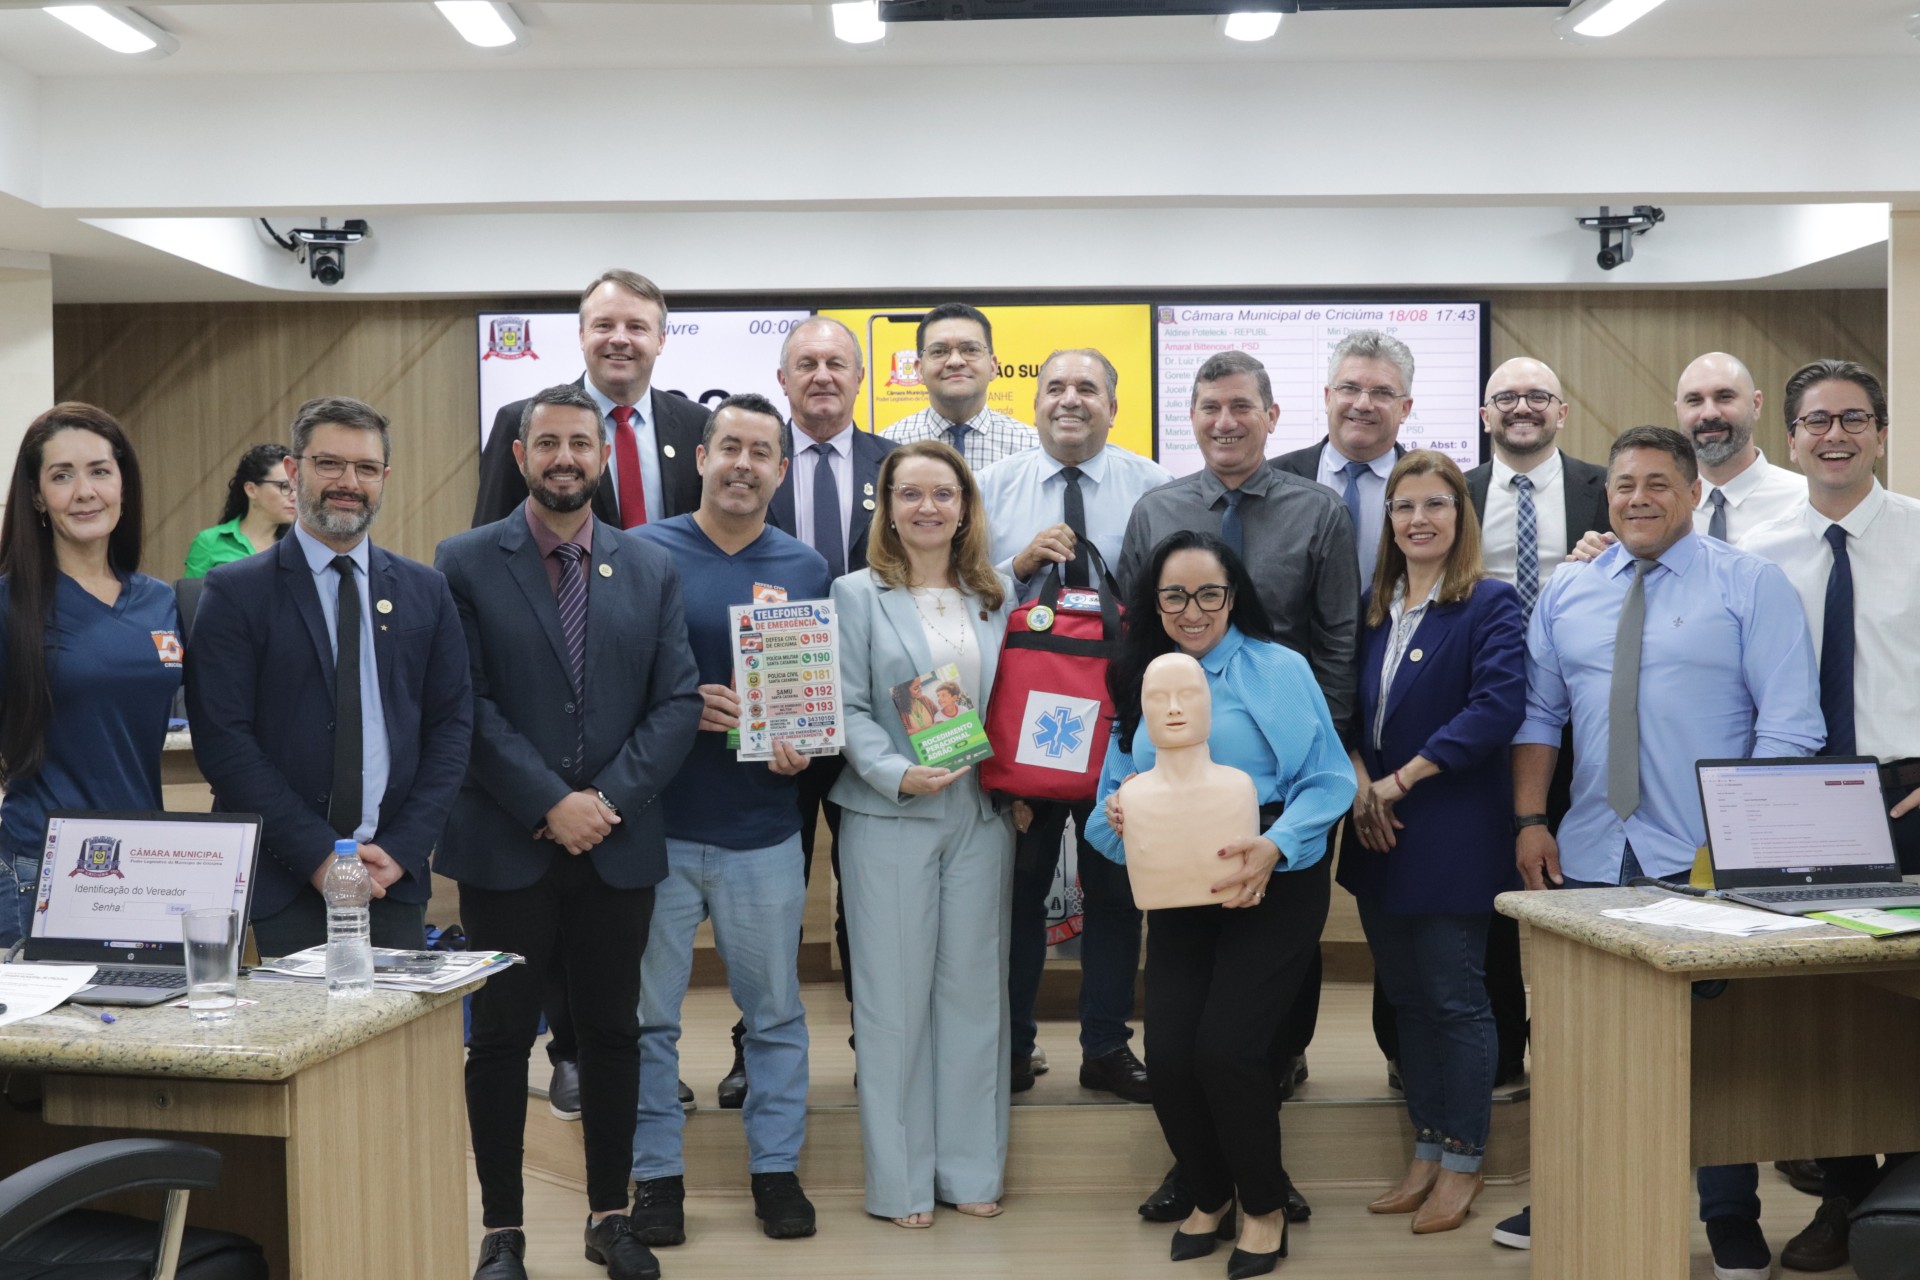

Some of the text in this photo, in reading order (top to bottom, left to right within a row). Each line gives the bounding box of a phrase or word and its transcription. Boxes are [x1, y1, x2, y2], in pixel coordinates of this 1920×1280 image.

[1182, 309, 1476, 322] Câmara Municipal de Criciúma 18/08 17:43
[1164, 328, 1190, 336] Aldinei
[1192, 328, 1227, 336] Potelecki
[1194, 342, 1234, 350] Bittencourt
[1242, 342, 1259, 350] PSD
[1164, 357, 1176, 365] Dr.
[1178, 357, 1194, 365] Luiz
[1018, 364, 1040, 378] SU
[1164, 371, 1191, 379] Gorete
[1164, 386, 1187, 394] Juceli
[988, 392, 1013, 401] ANHE
[1165, 428, 1191, 436] Marlon
[1406, 426, 1424, 434] PSD
[1430, 441, 1457, 449] Abst:
[756, 607, 810, 620] TELEFONES
[756, 618, 817, 630] DE EMERGÊNCIA
[811, 633, 829, 643] 199
[813, 652, 830, 662] 190
[813, 670, 830, 680] 181
[815, 685, 832, 696] 192
[816, 701, 833, 711] 193
[130, 848, 224, 859] CÂMARA MUNICIPAL
[74, 884, 187, 897] Identificação do Vereador
